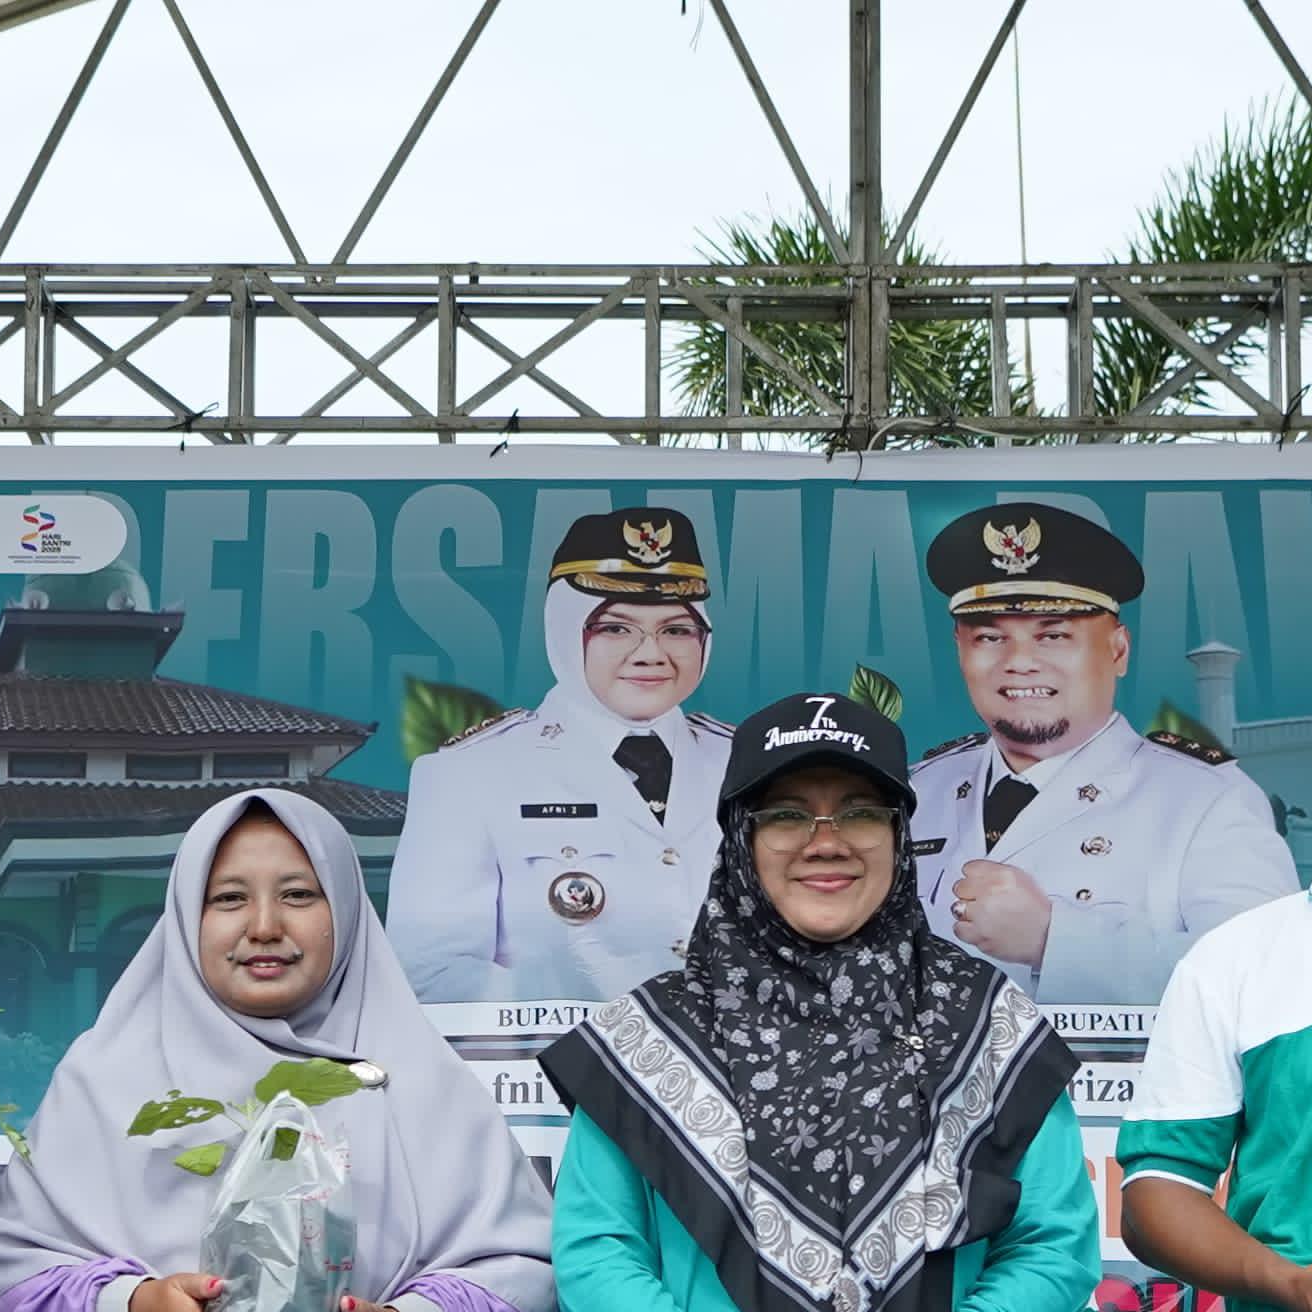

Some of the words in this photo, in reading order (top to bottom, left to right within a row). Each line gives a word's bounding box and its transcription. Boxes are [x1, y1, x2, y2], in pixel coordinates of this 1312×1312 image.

[497, 1006, 590, 1028] BUPATI
[1053, 1012, 1145, 1032] BUPATI
[1069, 1069, 1135, 1102] riza
